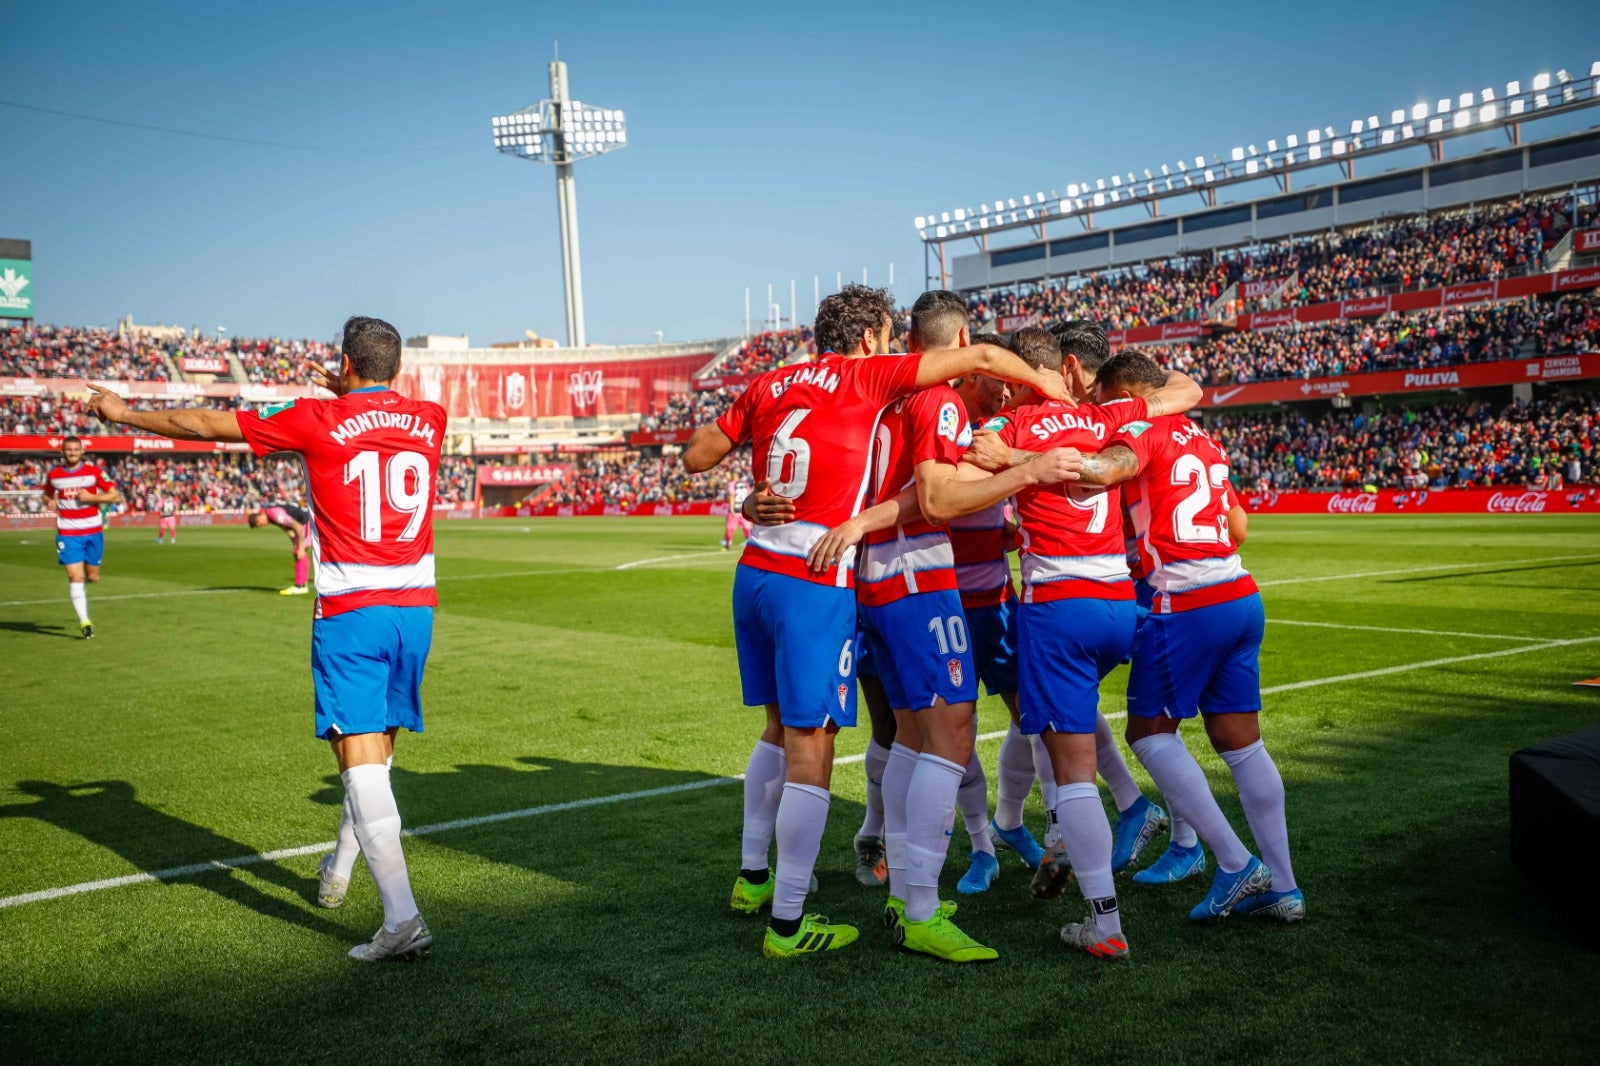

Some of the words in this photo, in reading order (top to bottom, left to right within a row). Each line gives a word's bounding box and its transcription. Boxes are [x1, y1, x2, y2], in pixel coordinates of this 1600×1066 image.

[1404, 371, 1459, 387] PULEVA
[134, 437, 174, 449] PULEVA
[329, 410, 412, 446] MONTORO
[766, 408, 812, 500] 6
[344, 450, 430, 543] 19
[928, 615, 968, 654] 10
[838, 639, 853, 677] 6
